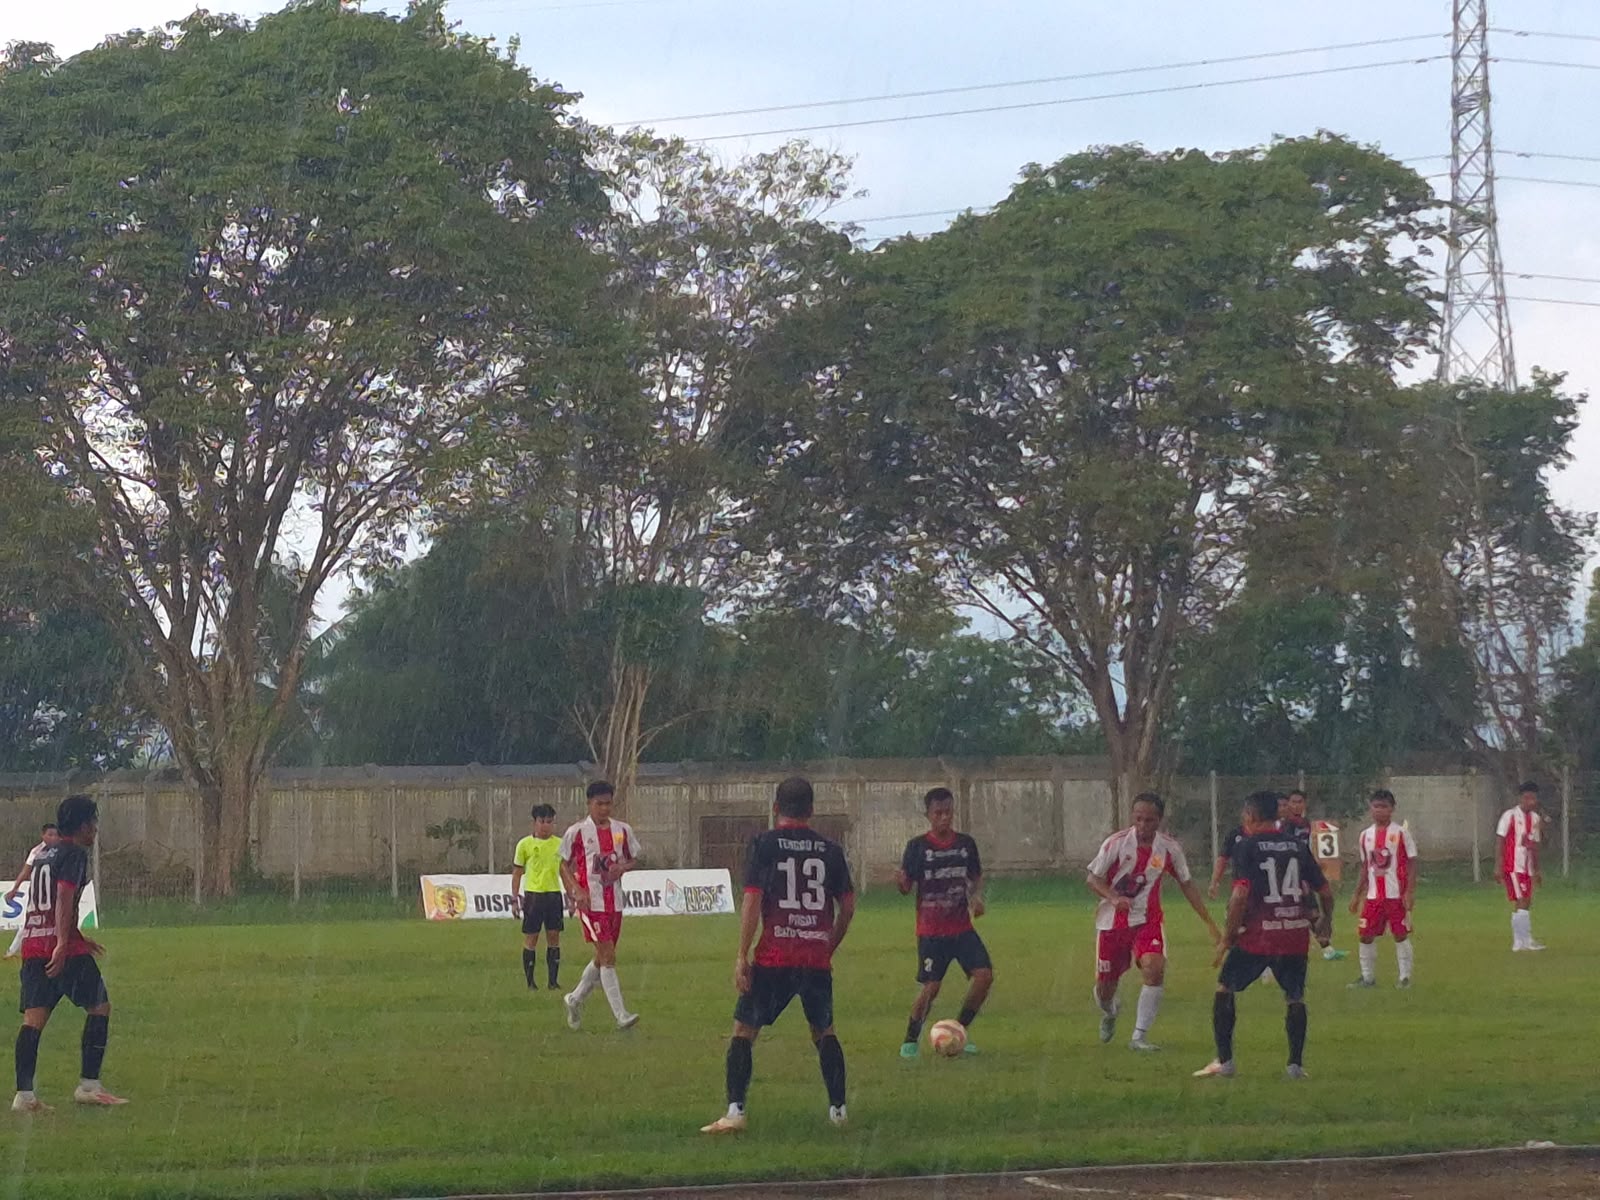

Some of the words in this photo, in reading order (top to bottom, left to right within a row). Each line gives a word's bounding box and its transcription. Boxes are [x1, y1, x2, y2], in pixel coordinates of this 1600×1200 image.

[1321, 834, 1336, 857] 3
[27, 863, 52, 912] 10
[777, 856, 826, 911] 13
[1258, 856, 1303, 904] 14
